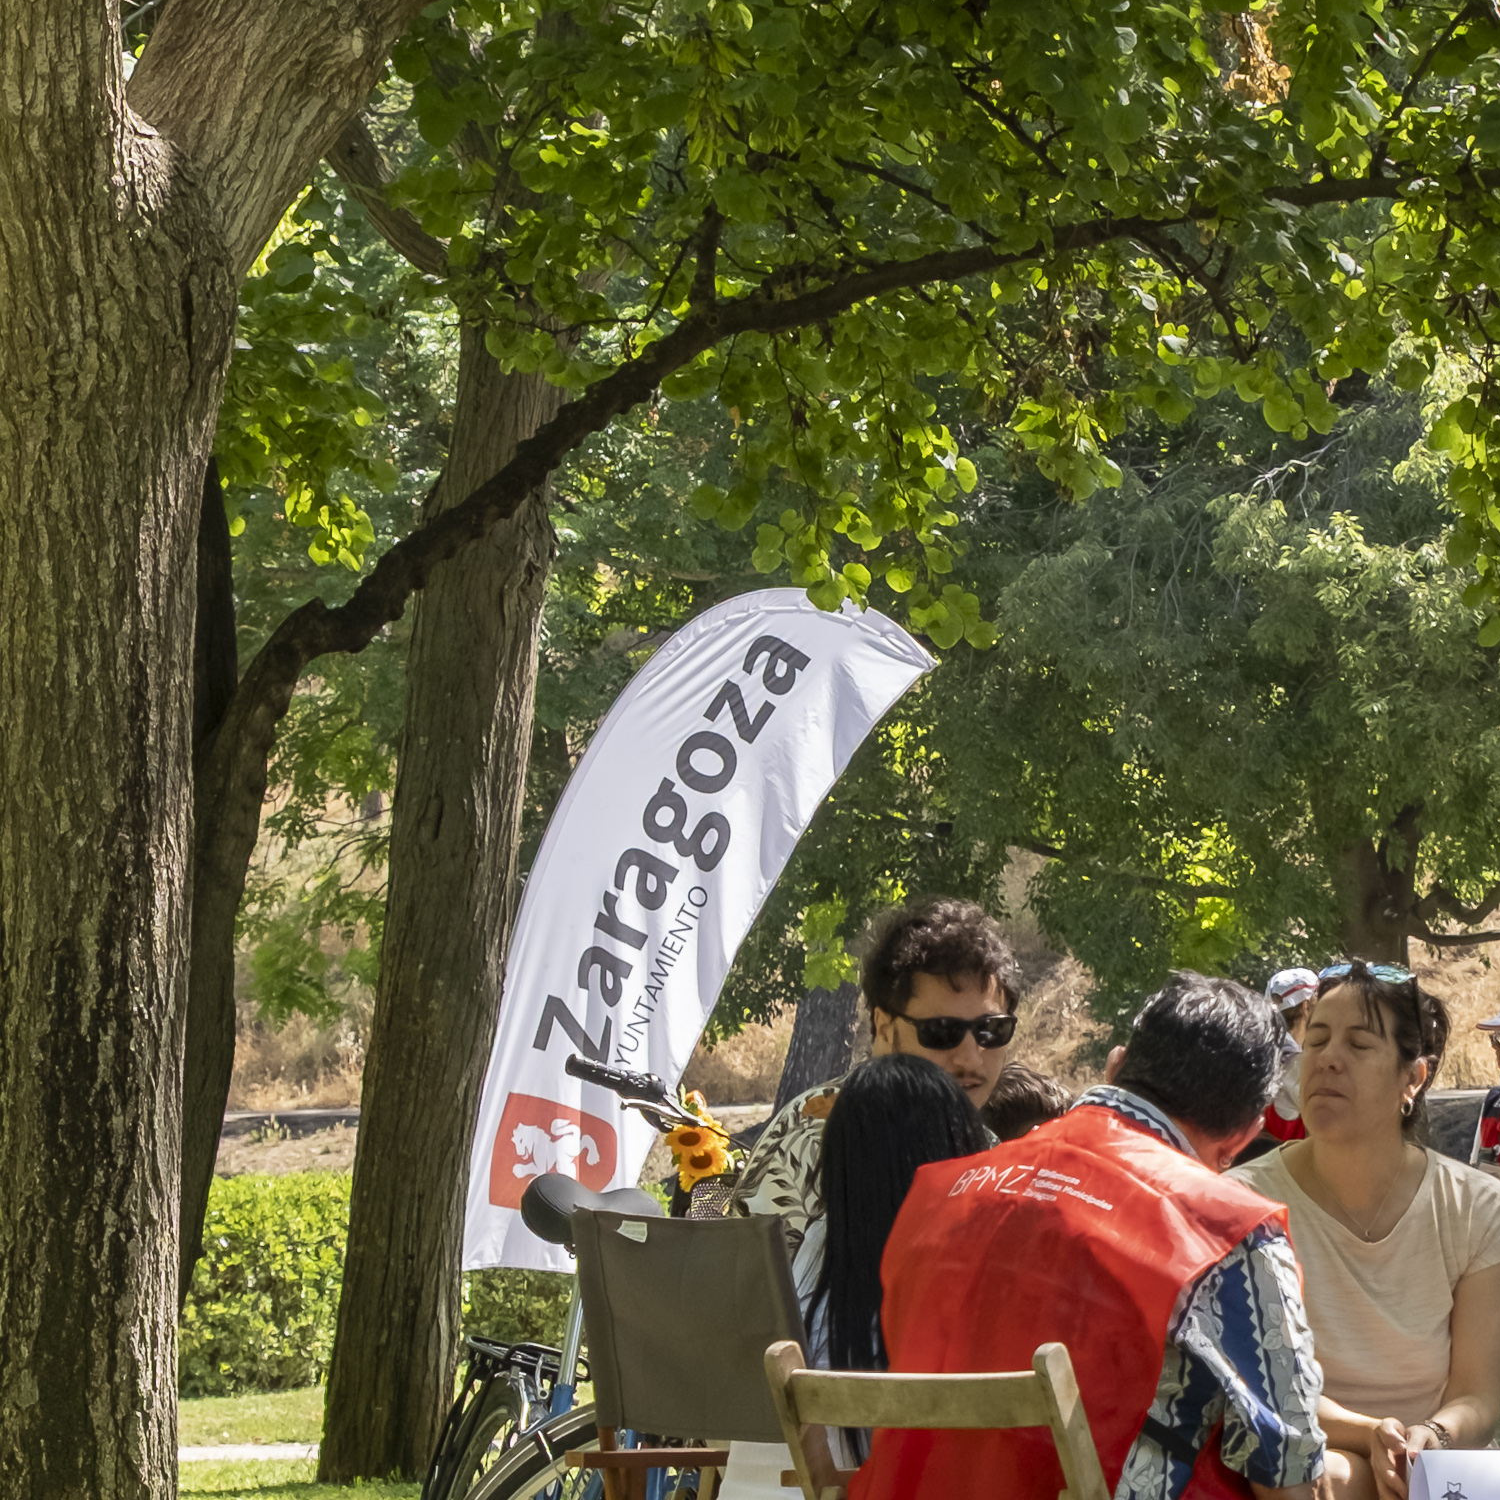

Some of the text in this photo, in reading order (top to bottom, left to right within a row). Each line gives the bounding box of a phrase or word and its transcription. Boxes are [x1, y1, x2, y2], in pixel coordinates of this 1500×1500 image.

[533, 634, 811, 1066] Zaragoza
[614, 886, 708, 1065] YUNTAMIENTO
[948, 1165, 1035, 1197] BPMZ
